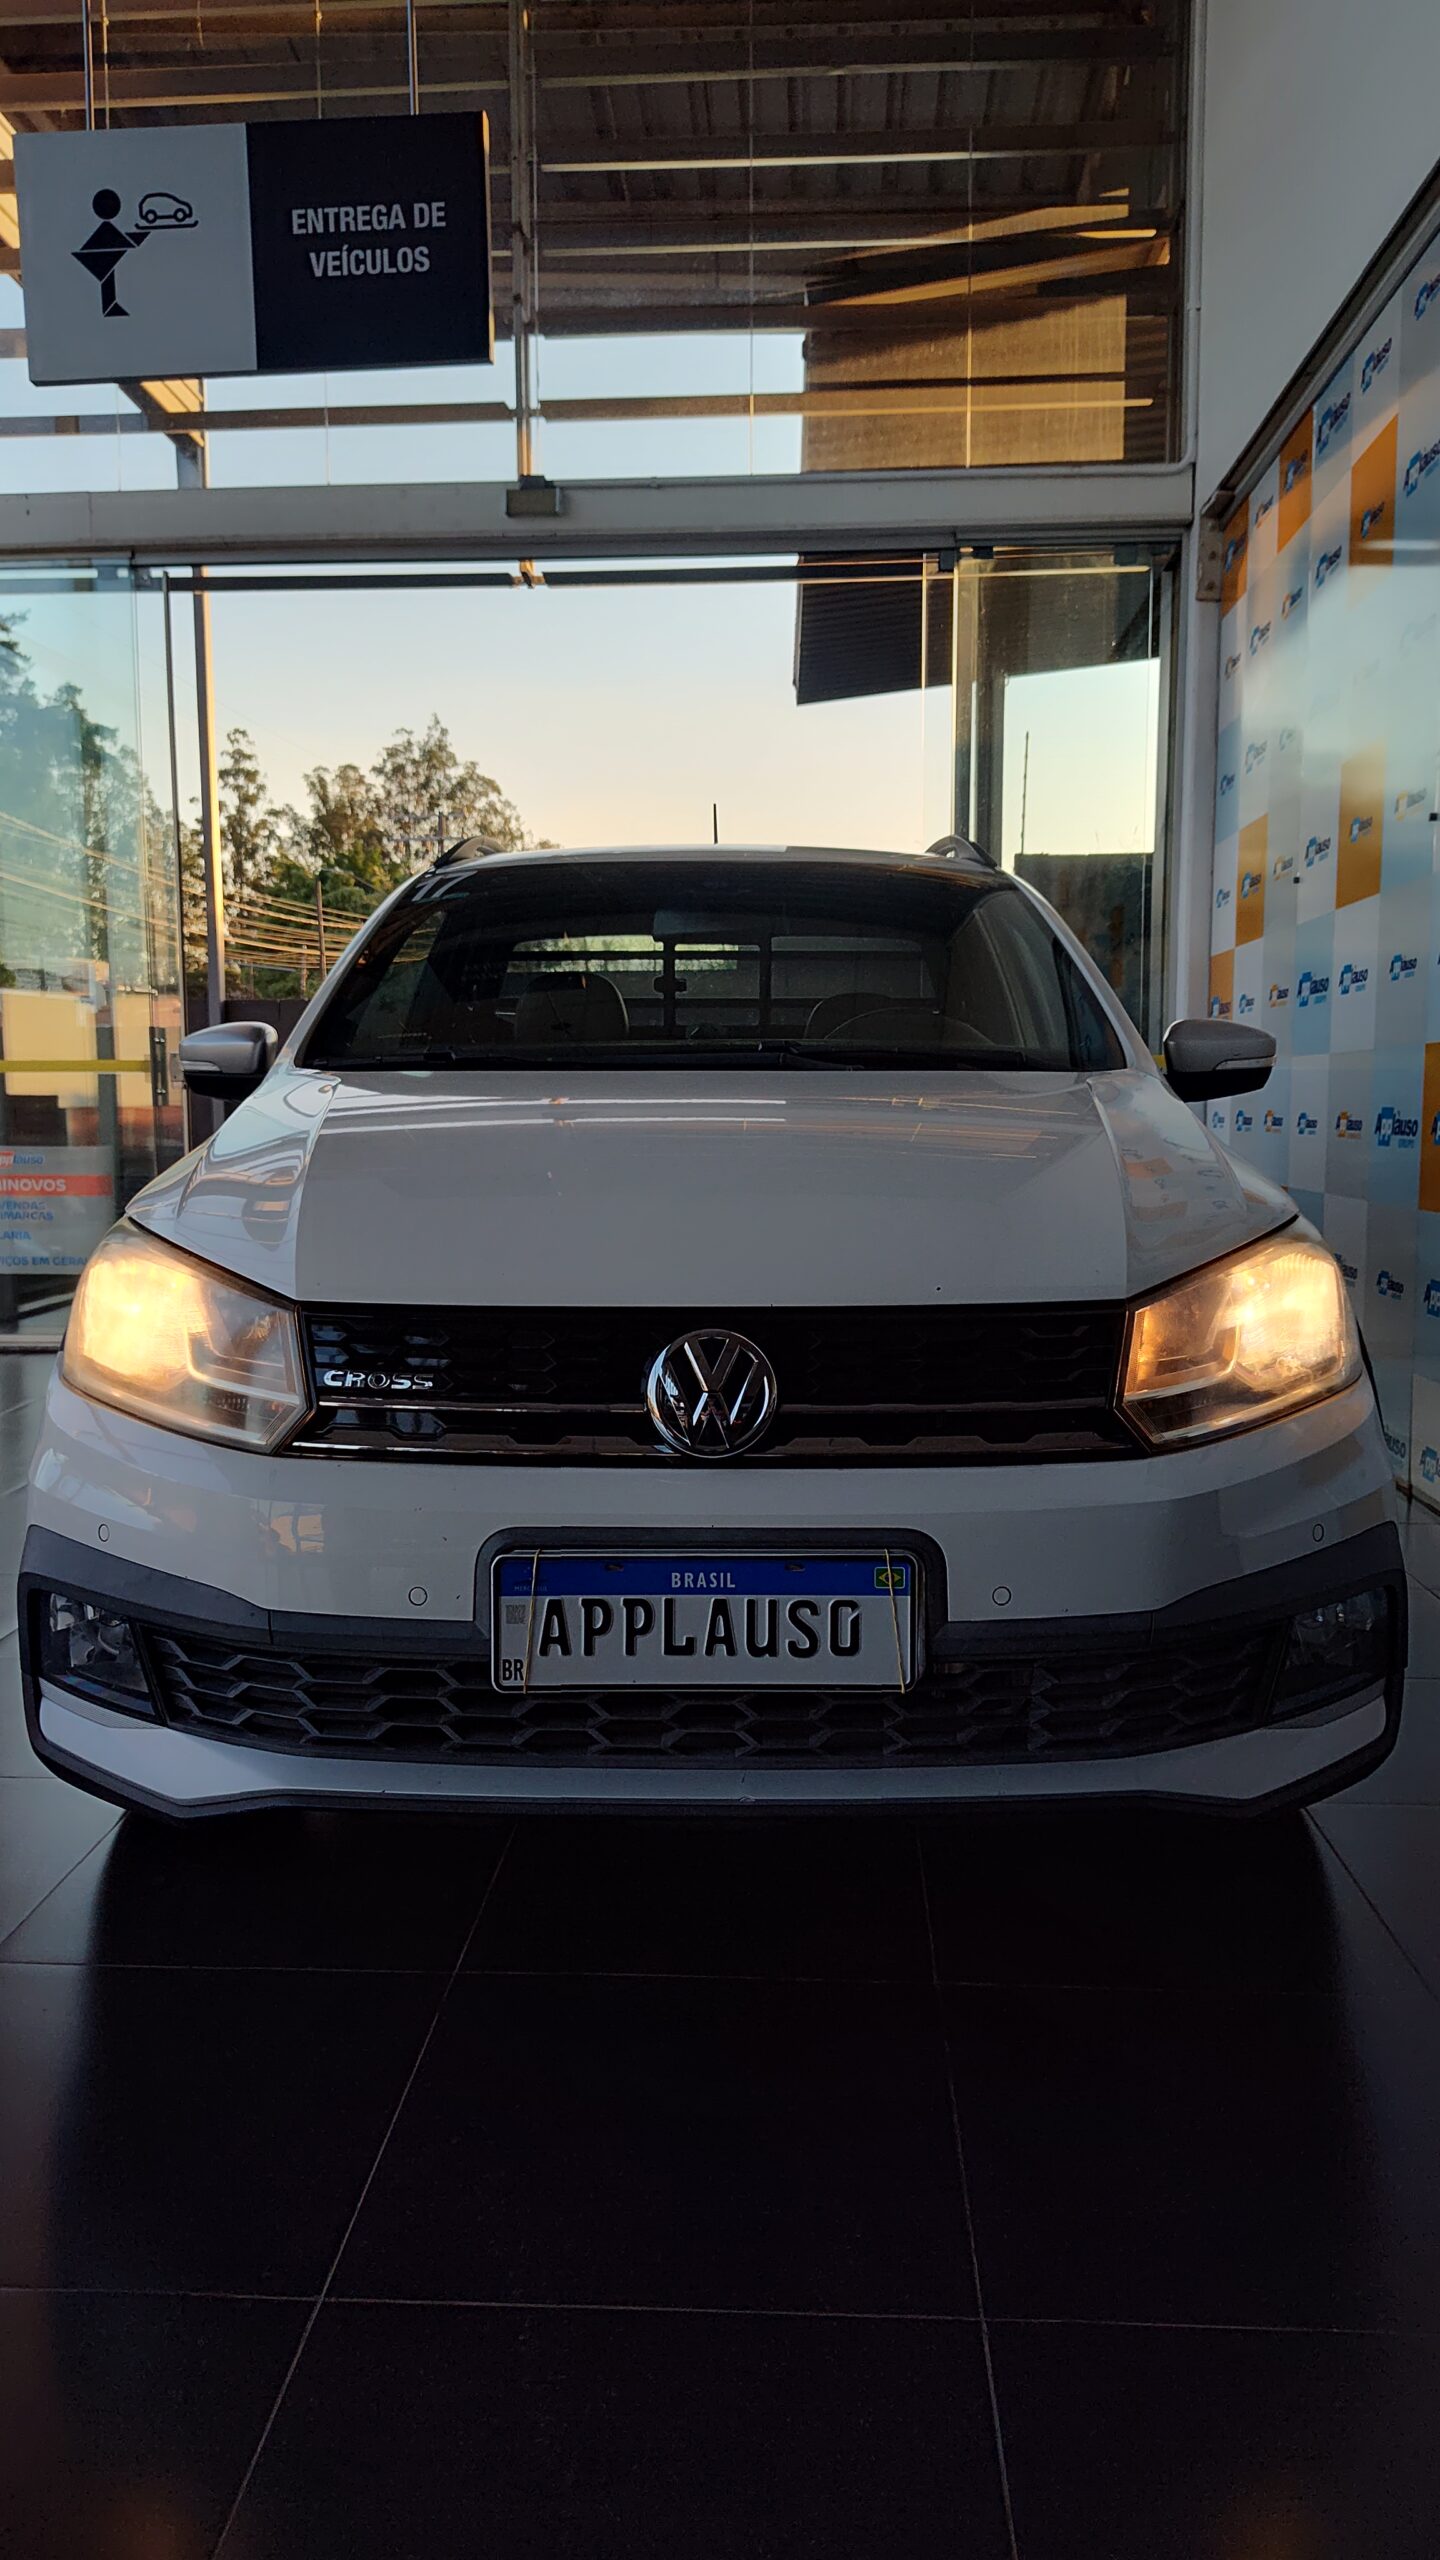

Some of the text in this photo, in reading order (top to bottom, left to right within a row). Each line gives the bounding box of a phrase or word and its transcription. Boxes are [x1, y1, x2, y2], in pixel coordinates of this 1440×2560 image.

[292, 201, 447, 235] ENTREGA DE
[309, 244, 431, 278] VEÍCULOS
[323, 1369, 434, 1391] CROSS
[670, 1571, 737, 1589] BRASIL
[537, 1597, 863, 1658] APPLAUSO
[501, 1658, 525, 1682] BR
